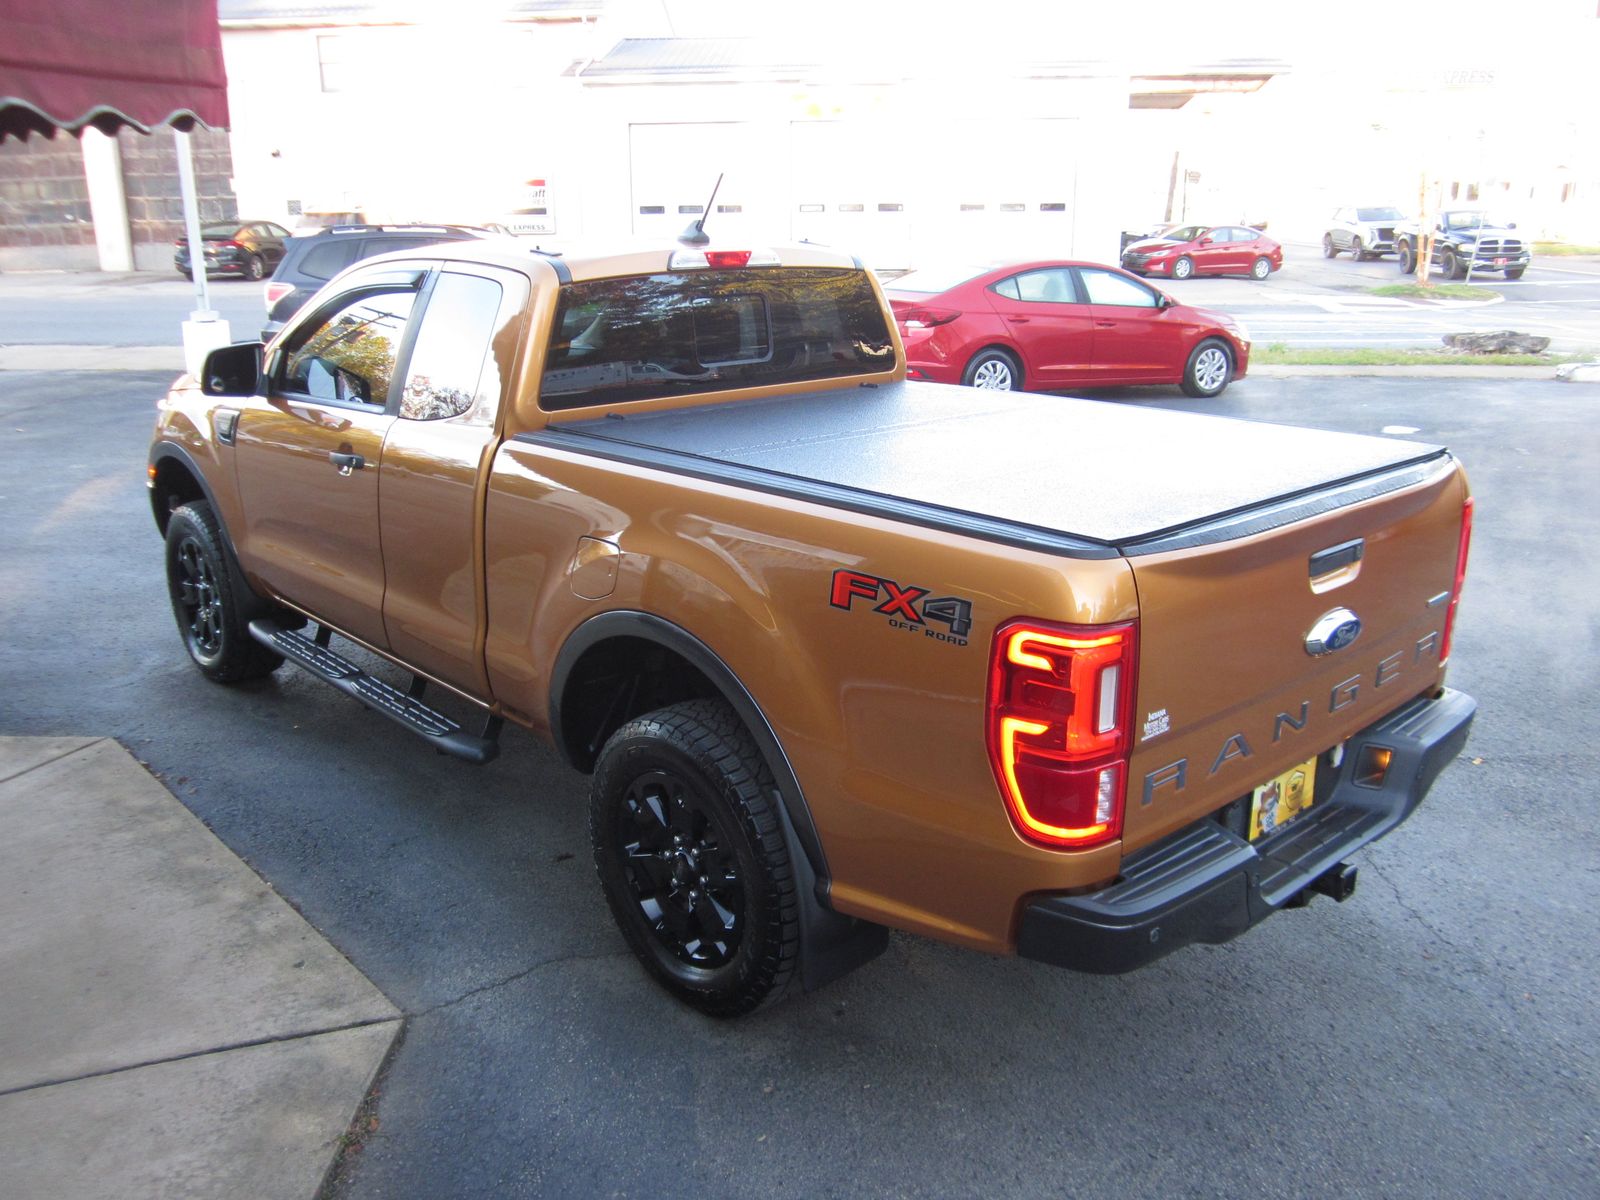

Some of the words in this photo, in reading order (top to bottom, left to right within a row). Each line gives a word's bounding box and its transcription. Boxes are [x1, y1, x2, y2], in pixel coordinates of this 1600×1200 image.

[829, 568, 972, 637] FX4
[888, 618, 919, 632] OFF
[925, 629, 968, 647] ROAD
[1141, 631, 1439, 807] RANGER
